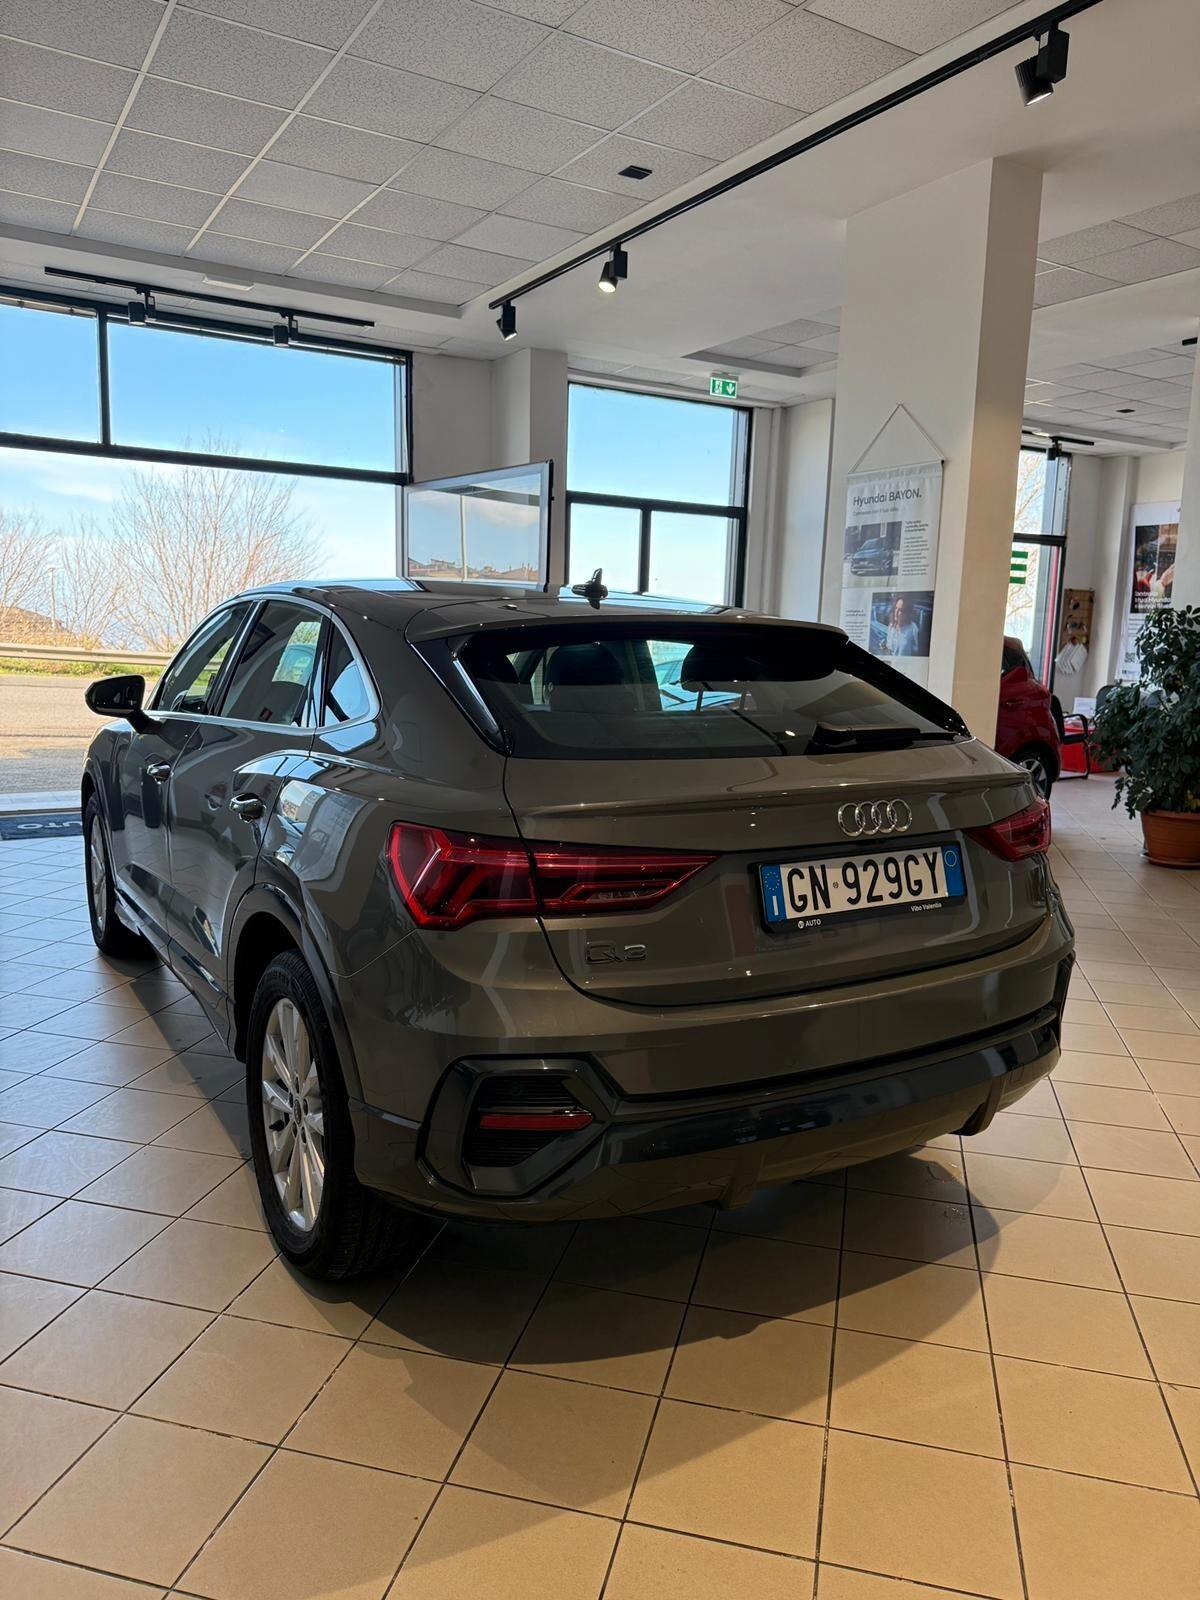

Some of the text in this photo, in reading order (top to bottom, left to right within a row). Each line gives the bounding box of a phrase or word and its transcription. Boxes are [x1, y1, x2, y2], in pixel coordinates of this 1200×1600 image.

[853, 488, 922, 507] Hyundai BAYON.
[787, 864, 831, 913] GN
[841, 851, 939, 905] 929GY
[911, 904, 922, 912] Vibo
[805, 919, 821, 927] AUTO
[585, 940, 648, 965] Q3
